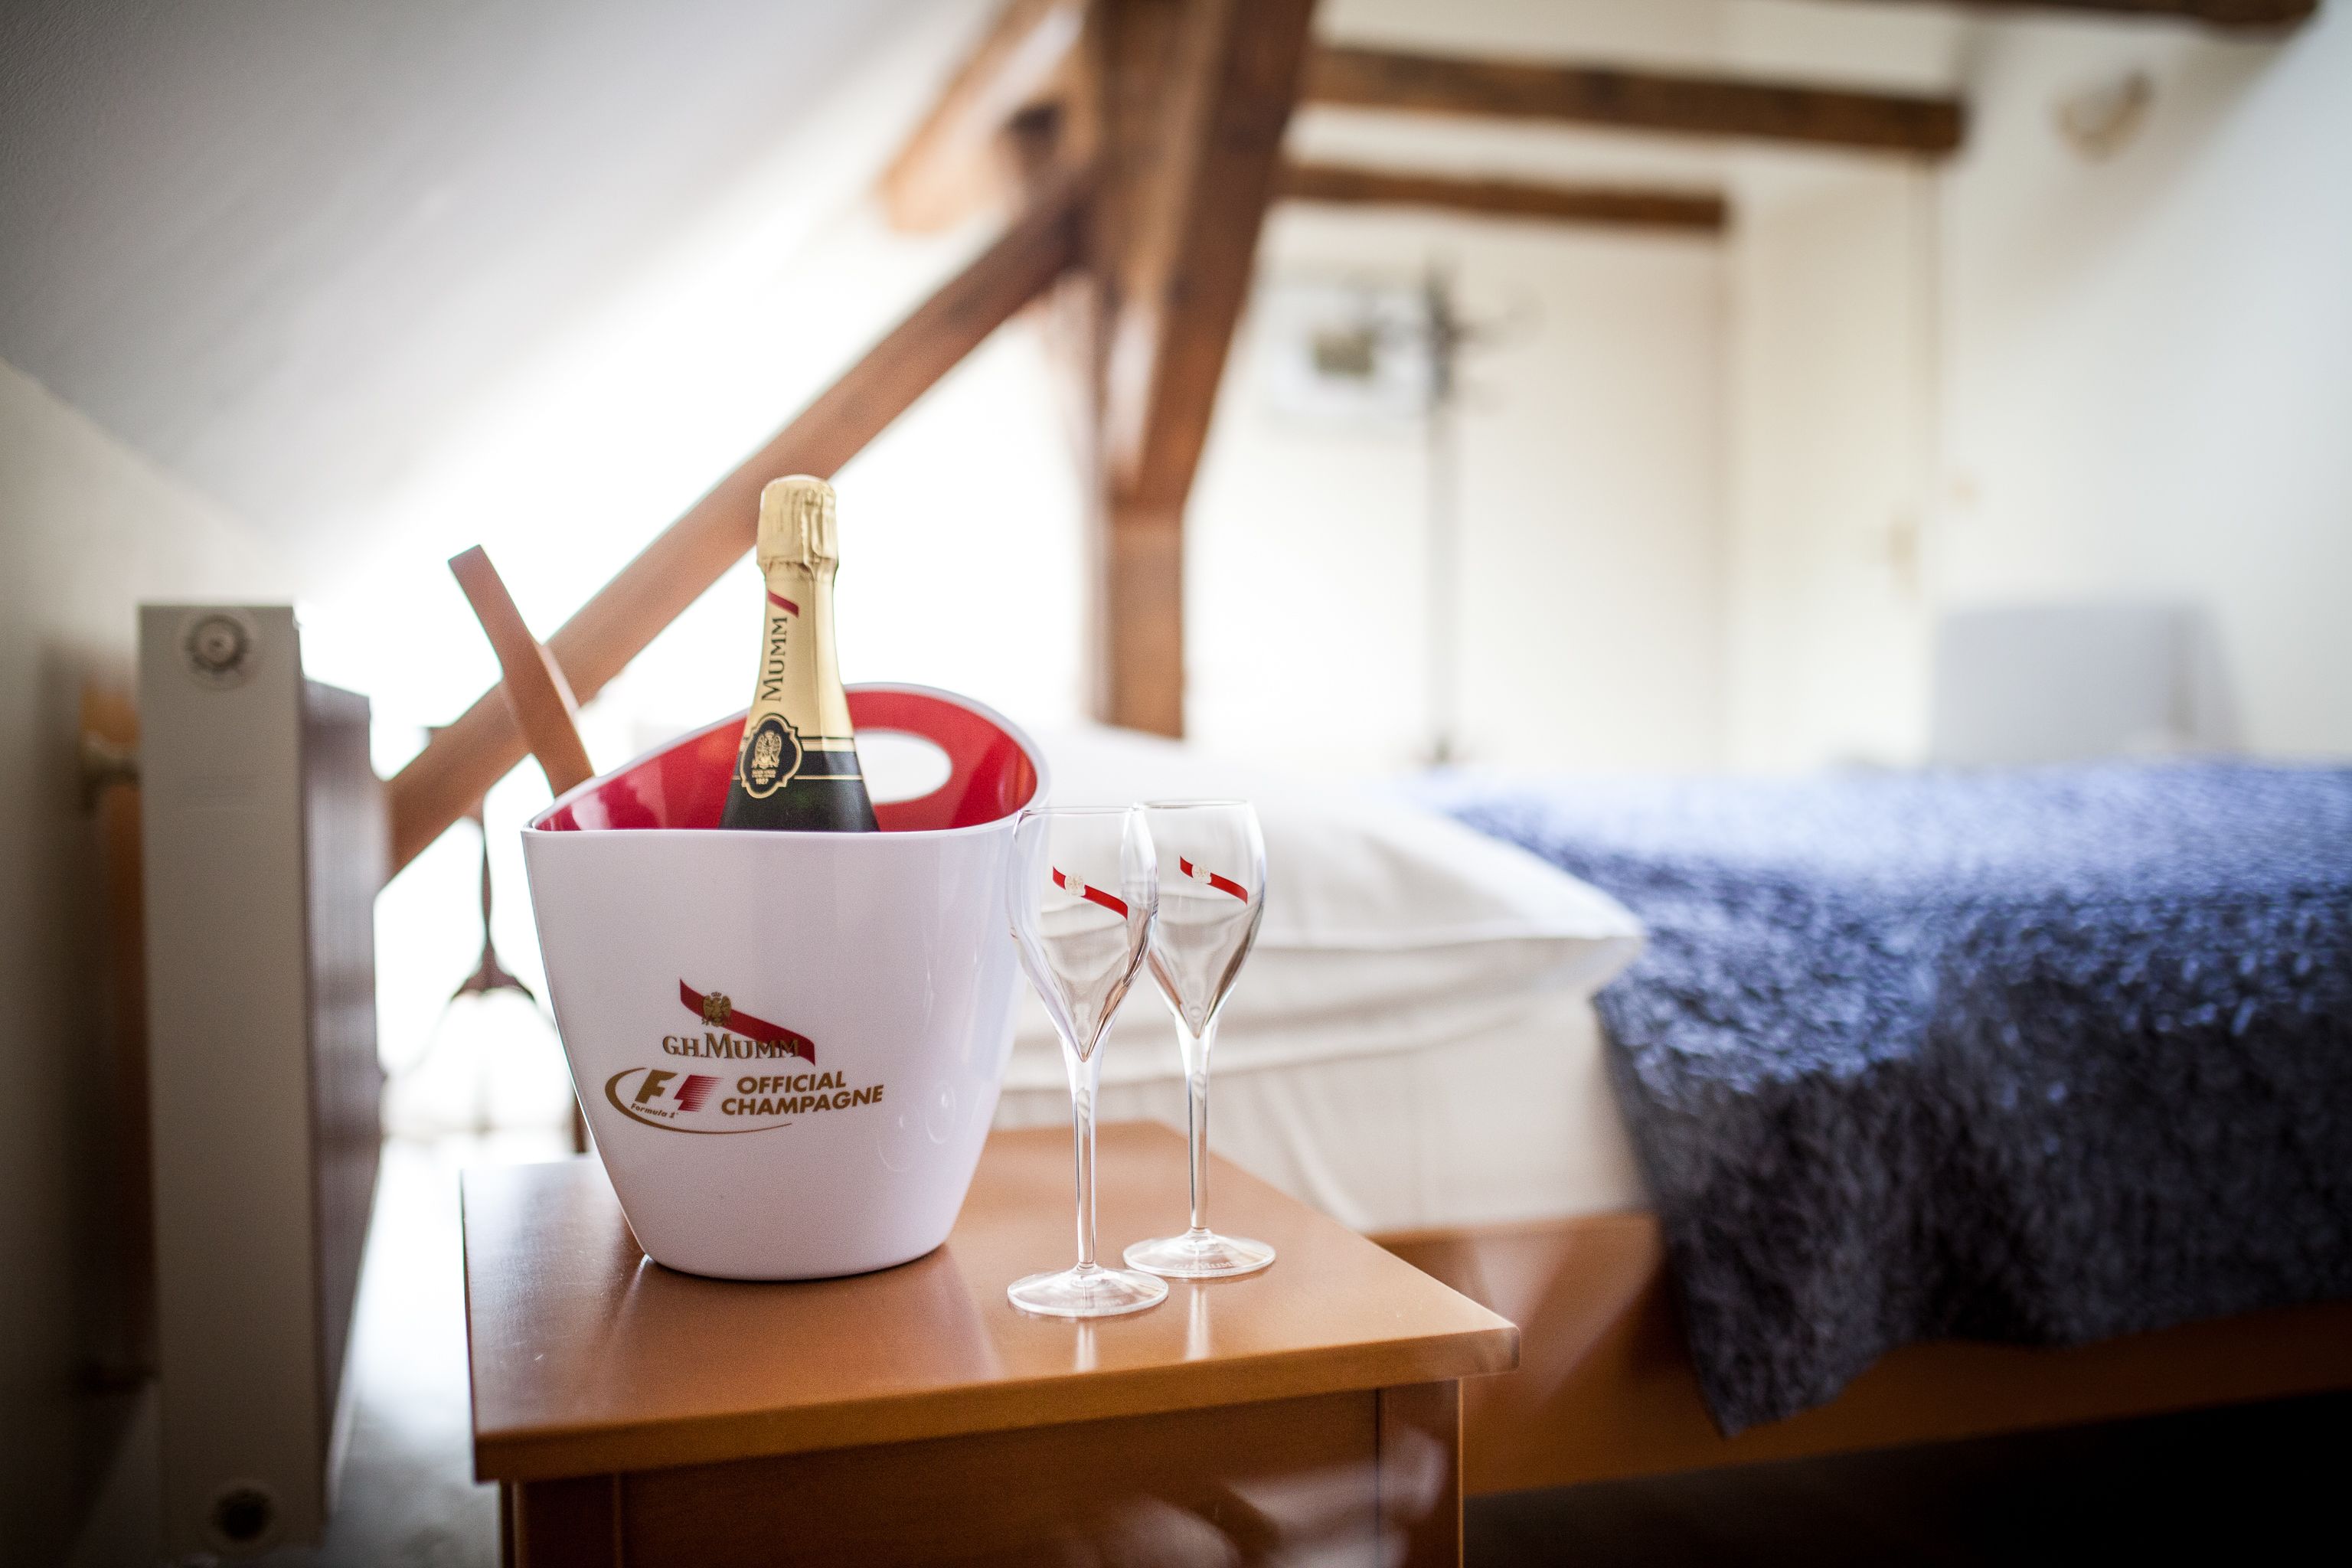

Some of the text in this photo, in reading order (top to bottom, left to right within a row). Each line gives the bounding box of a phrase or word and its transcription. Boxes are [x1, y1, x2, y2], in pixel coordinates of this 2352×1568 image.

[761, 616, 787, 701] MUMM
[737, 1071, 846, 1094] OFFICIAL
[631, 1103, 668, 1117] Formula
[721, 1084, 884, 1116] CHAMPAGNE
